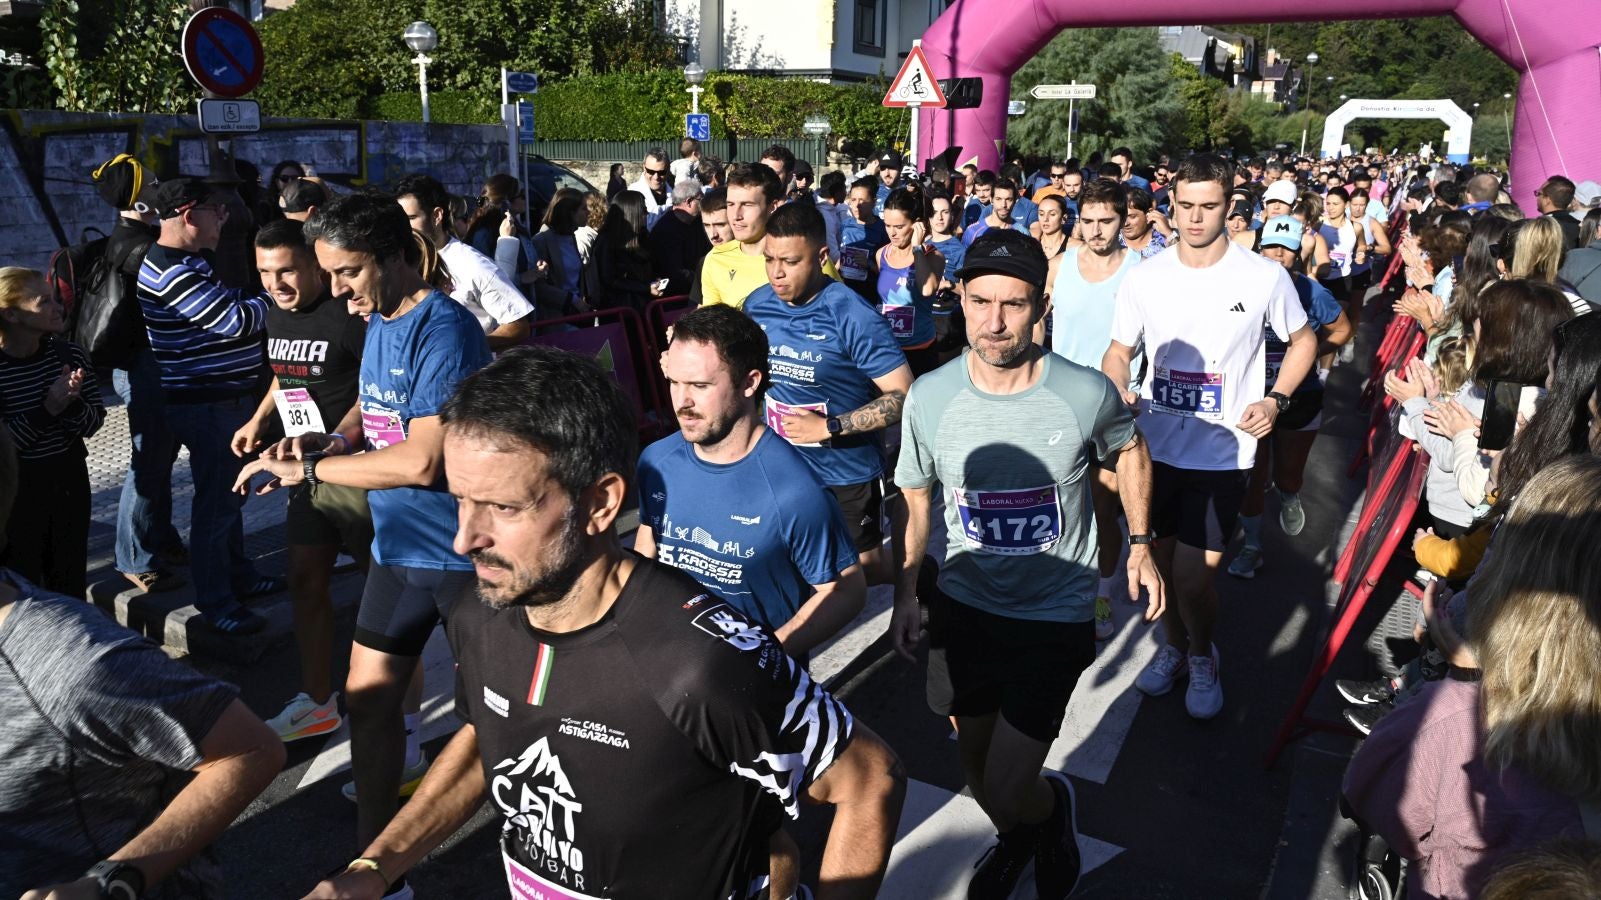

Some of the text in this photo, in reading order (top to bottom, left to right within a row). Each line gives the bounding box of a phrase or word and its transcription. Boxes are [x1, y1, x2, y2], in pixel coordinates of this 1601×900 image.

[1274, 223, 1290, 233] M
[287, 365, 309, 376] CLUB
[771, 363, 815, 378] KROSSA
[1177, 383, 1203, 391] CABRA
[1159, 385, 1216, 409] 1515
[288, 409, 311, 426] 381
[967, 514, 1053, 541] 4172
[677, 552, 743, 579] KROSSA
[678, 563, 704, 575] CROSS
[582, 720, 607, 734] CASA
[558, 723, 631, 750] ASTIGARRAGA
